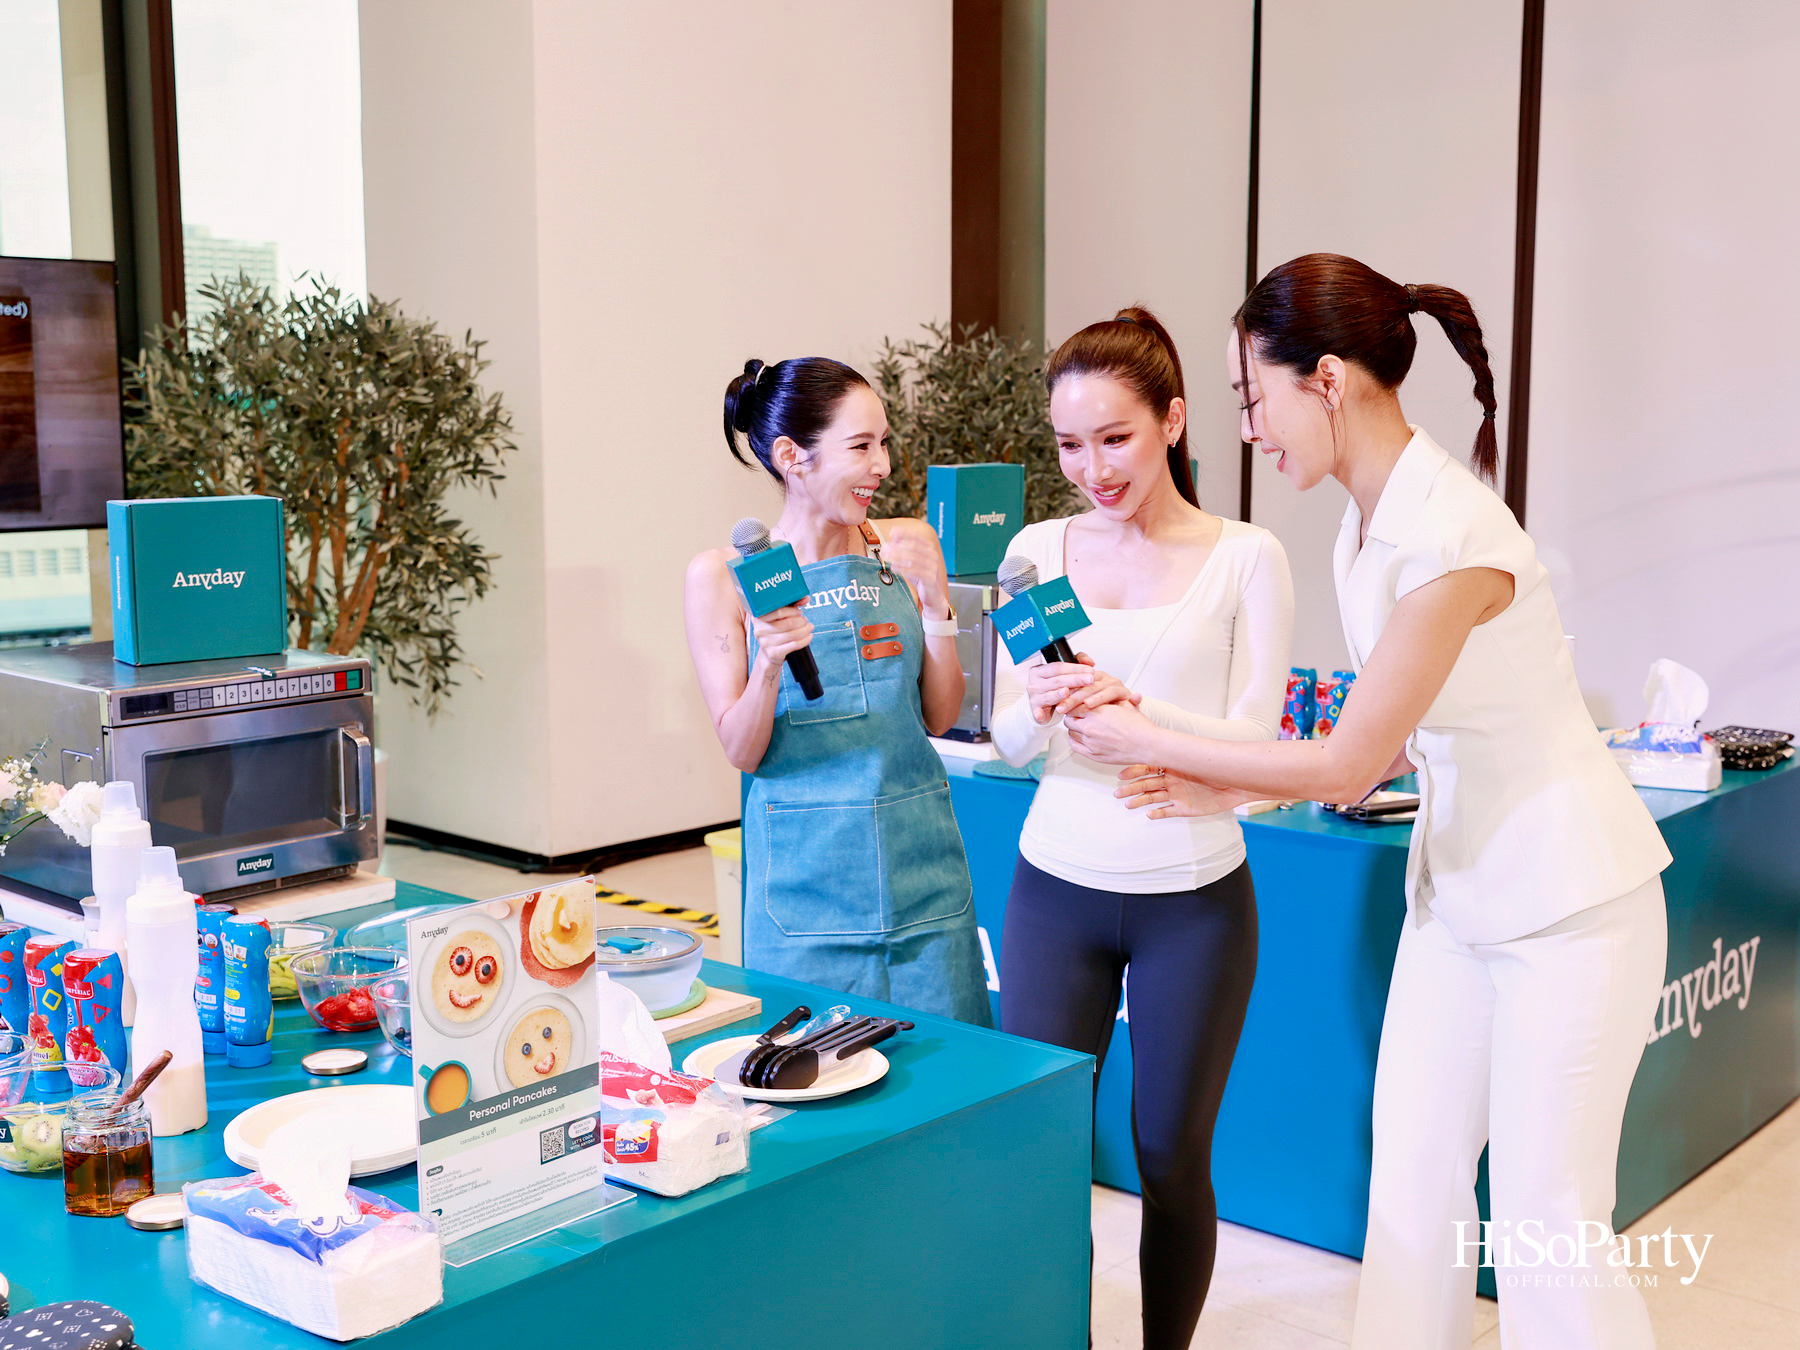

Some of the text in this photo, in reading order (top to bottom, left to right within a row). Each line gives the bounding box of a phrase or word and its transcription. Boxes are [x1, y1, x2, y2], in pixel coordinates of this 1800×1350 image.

[972, 511, 1006, 526] Anyday
[172, 568, 245, 590] Anyday
[754, 569, 792, 592] Anyday
[798, 579, 880, 610] nyday
[1044, 598, 1075, 616] Anyday
[1005, 616, 1034, 639] Anyday
[239, 858, 272, 871] Anyday
[421, 926, 449, 938] Anyday
[1647, 936, 1760, 1045] nyday
[469, 1086, 557, 1121] Personal Pancakes
[542, 1107, 554, 1117] 2.30
[486, 1127, 497, 1136] นาที
